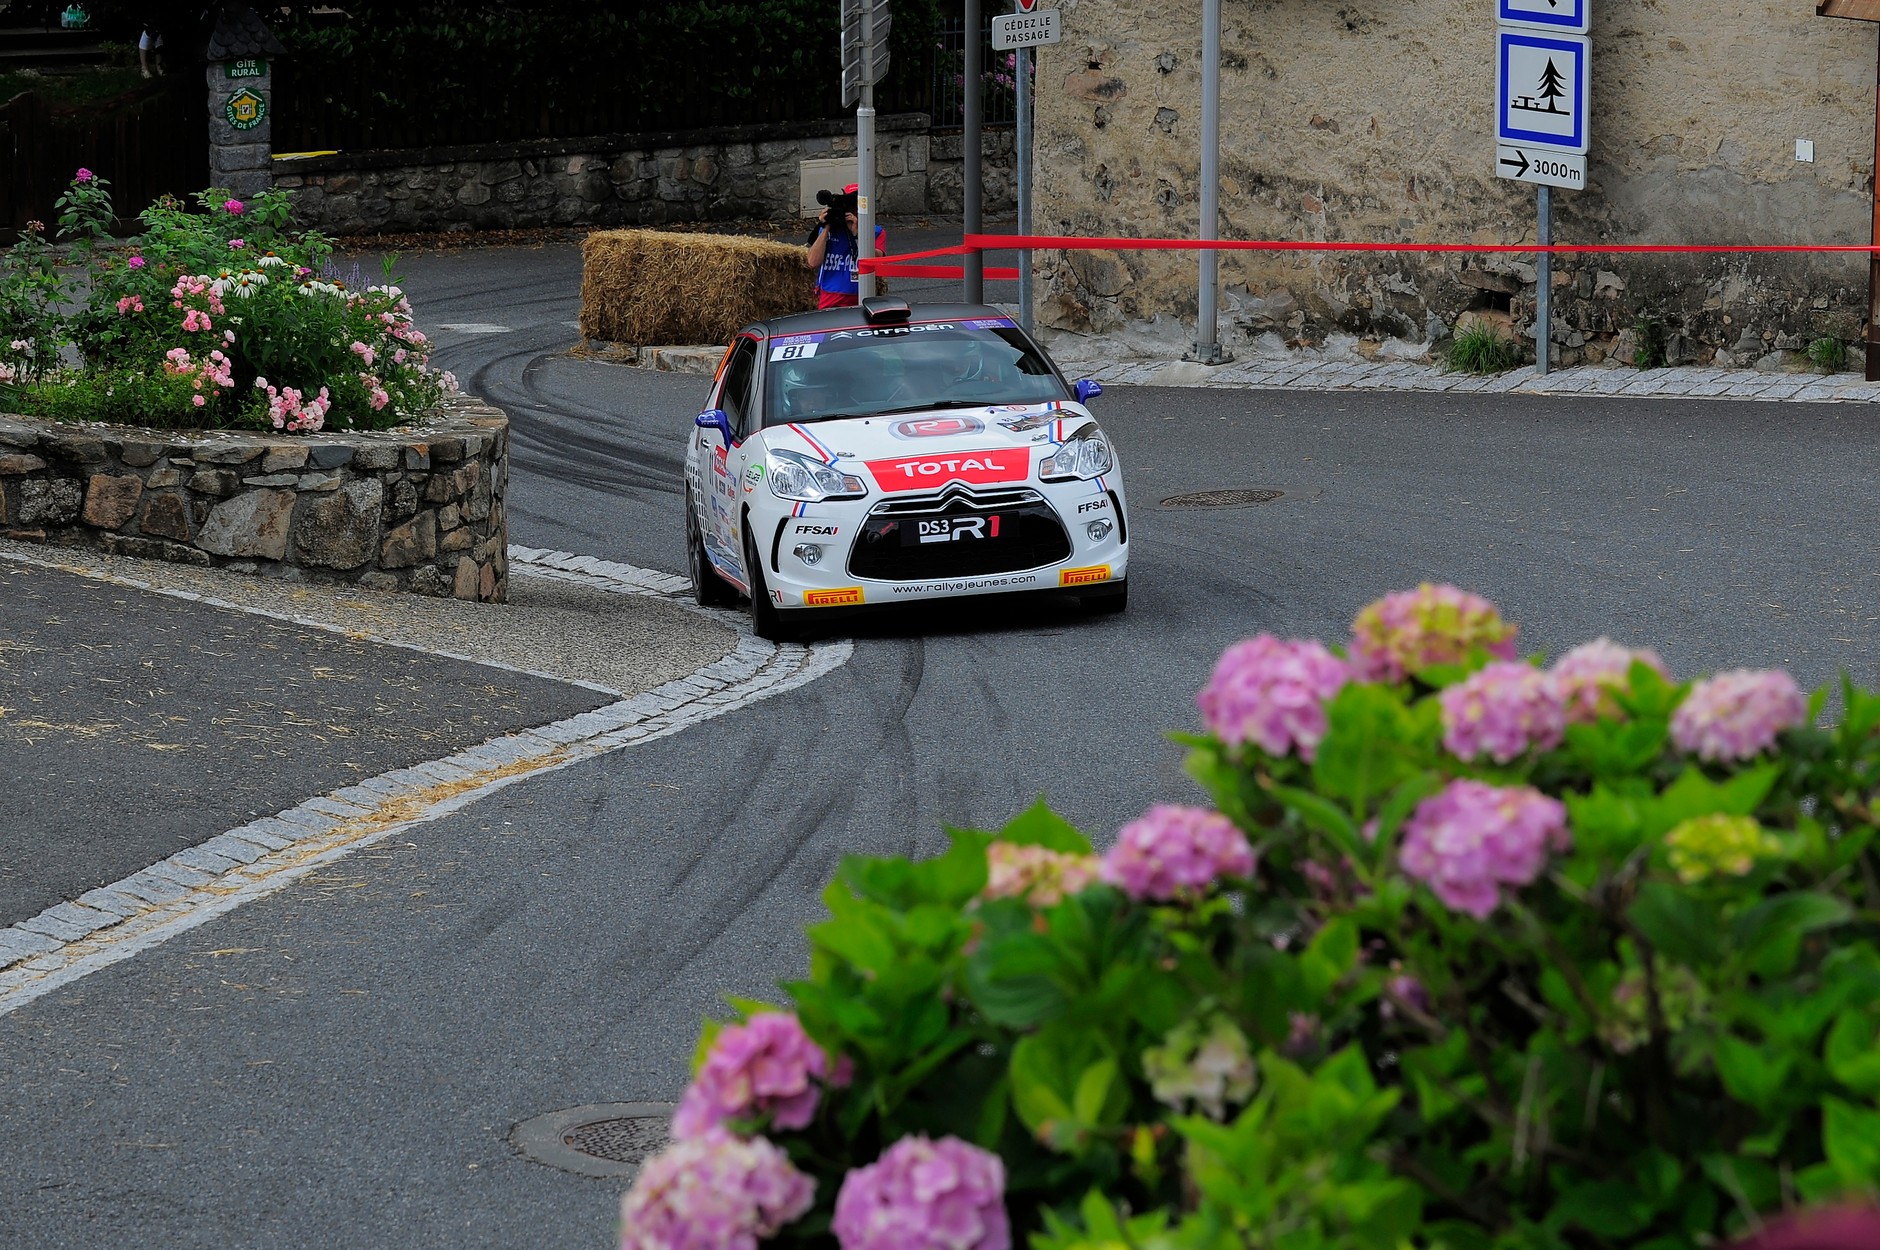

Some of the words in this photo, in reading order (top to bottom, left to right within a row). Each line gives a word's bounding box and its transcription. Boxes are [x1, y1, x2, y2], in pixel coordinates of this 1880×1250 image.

[1004, 19, 1036, 31] CÉDEZ
[1040, 17, 1051, 26] LE
[1005, 30, 1050, 43] PASSAGE
[231, 67, 260, 77] RURAL
[248, 103, 265, 128] FRANCE
[782, 345, 805, 359] 81
[896, 458, 1005, 477] TOTAL
[1078, 501, 1107, 514] FFSA
[795, 525, 832, 535] FFSA
[918, 519, 950, 535] DS3
[952, 515, 1000, 541] R1
[1063, 568, 1106, 583] PIRELLI
[892, 573, 1036, 594] www.rallyejeunes.com
[808, 589, 858, 604] PIRELLI
